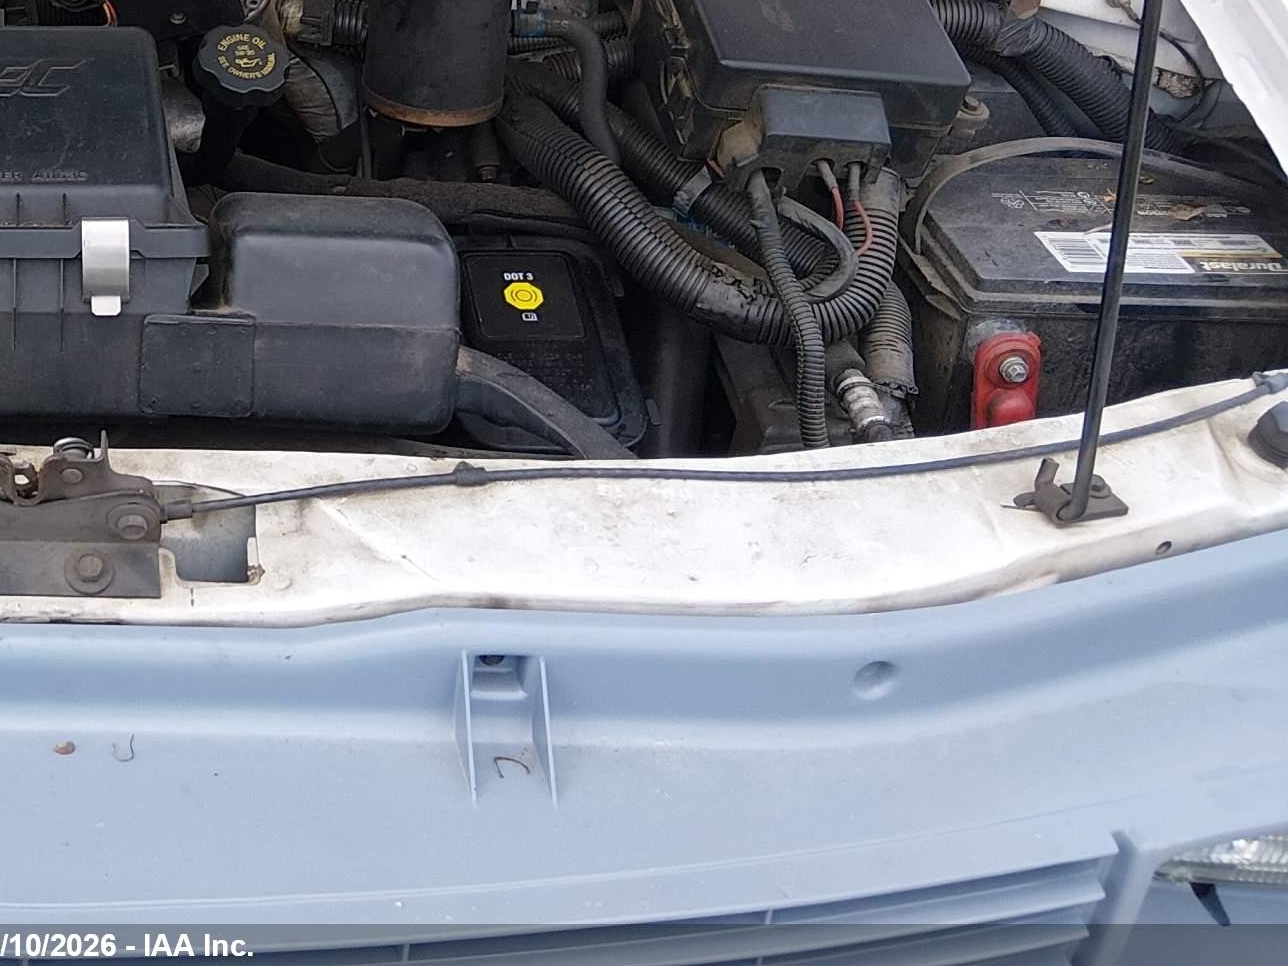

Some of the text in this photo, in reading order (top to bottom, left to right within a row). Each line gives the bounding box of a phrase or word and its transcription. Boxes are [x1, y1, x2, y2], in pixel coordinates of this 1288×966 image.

[217, 33, 266, 52] ENGINE OIL
[217, 55, 230, 69] SEE
[261, 52, 276, 76] MANUAL
[1200, 261, 1283, 272] Duralast
[503, 272, 534, 281] DOT 3
